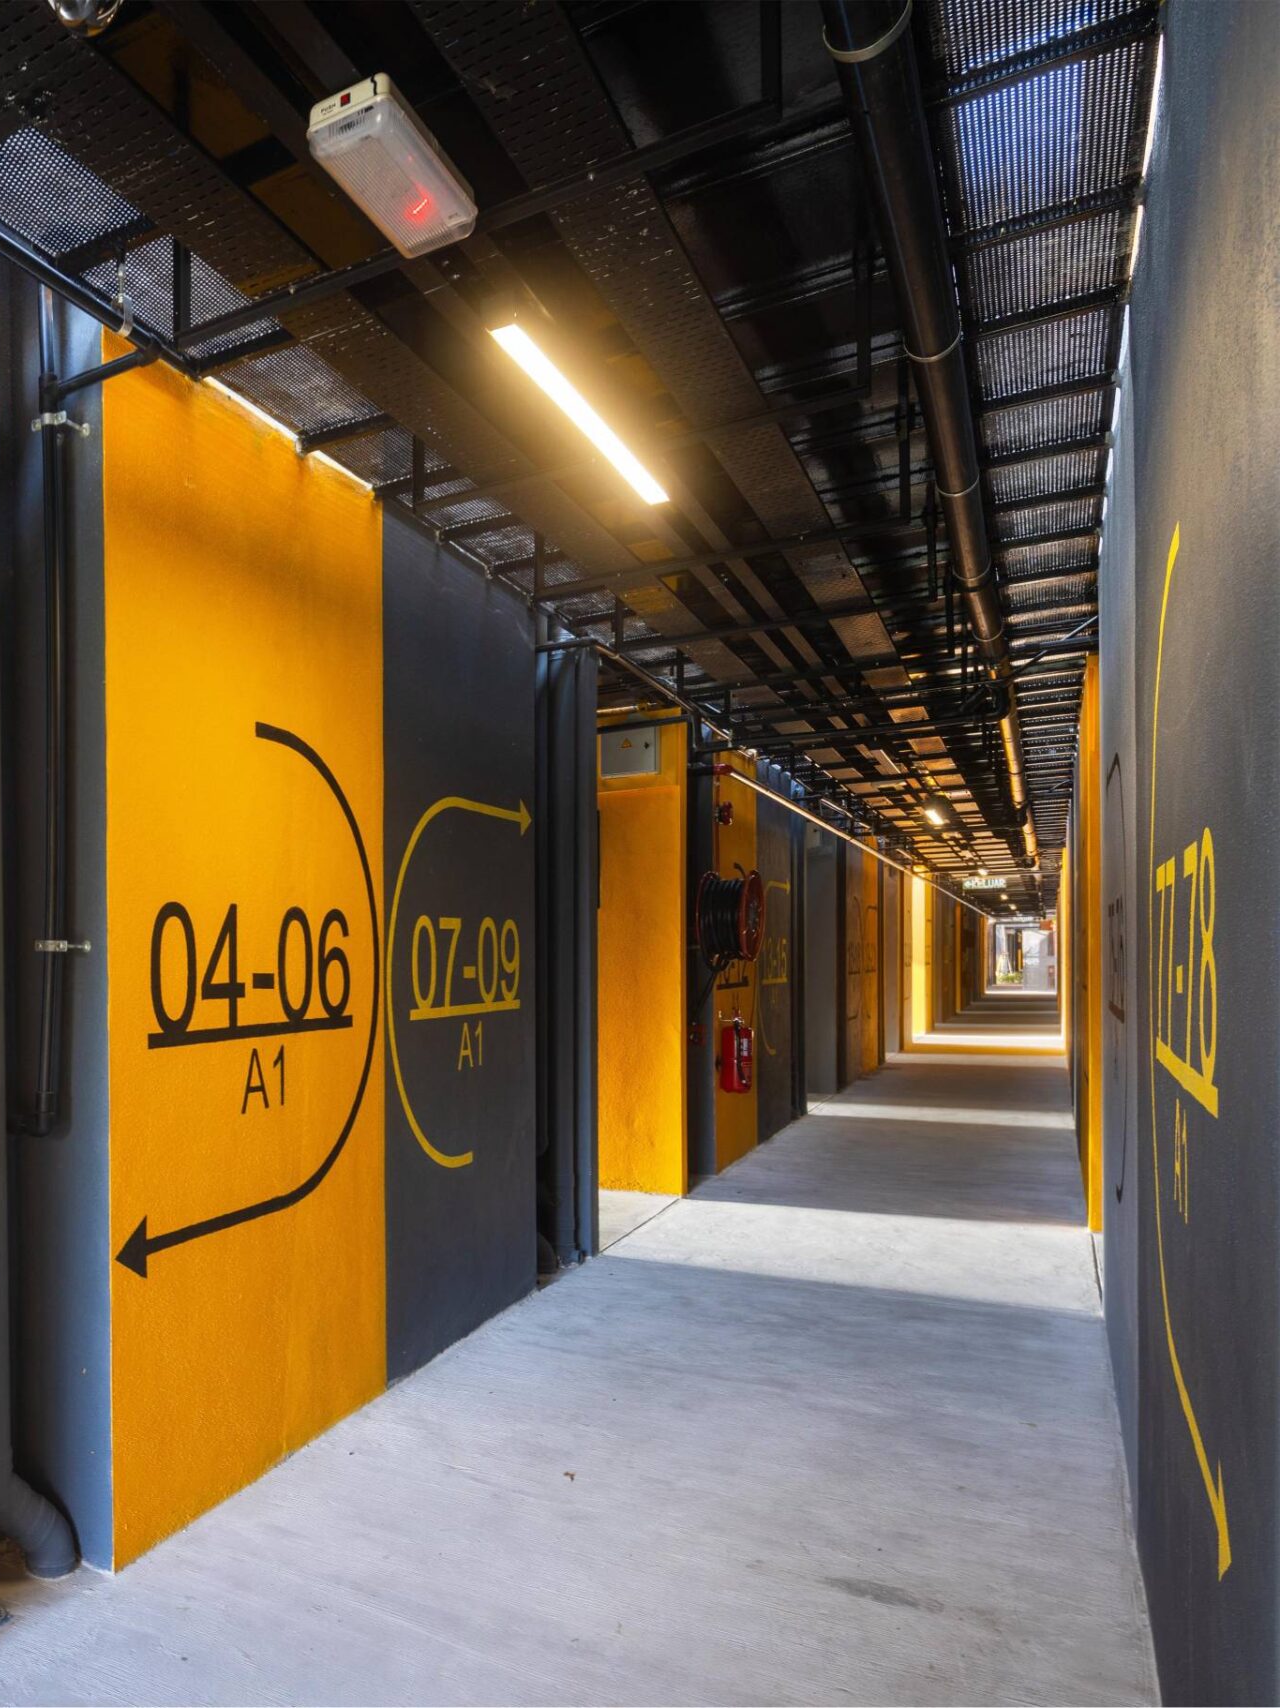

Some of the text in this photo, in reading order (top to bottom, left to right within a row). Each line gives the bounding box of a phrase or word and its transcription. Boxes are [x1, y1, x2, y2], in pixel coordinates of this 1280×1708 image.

[972, 878, 1006, 889] KELUAR
[150, 901, 351, 1033] 04-06
[411, 914, 520, 1010] 07-09
[1156, 827, 1216, 1085] 77-78
[241, 1044, 285, 1115] A1
[458, 1020, 484, 1071] A1
[1174, 1098, 1188, 1225] A1
